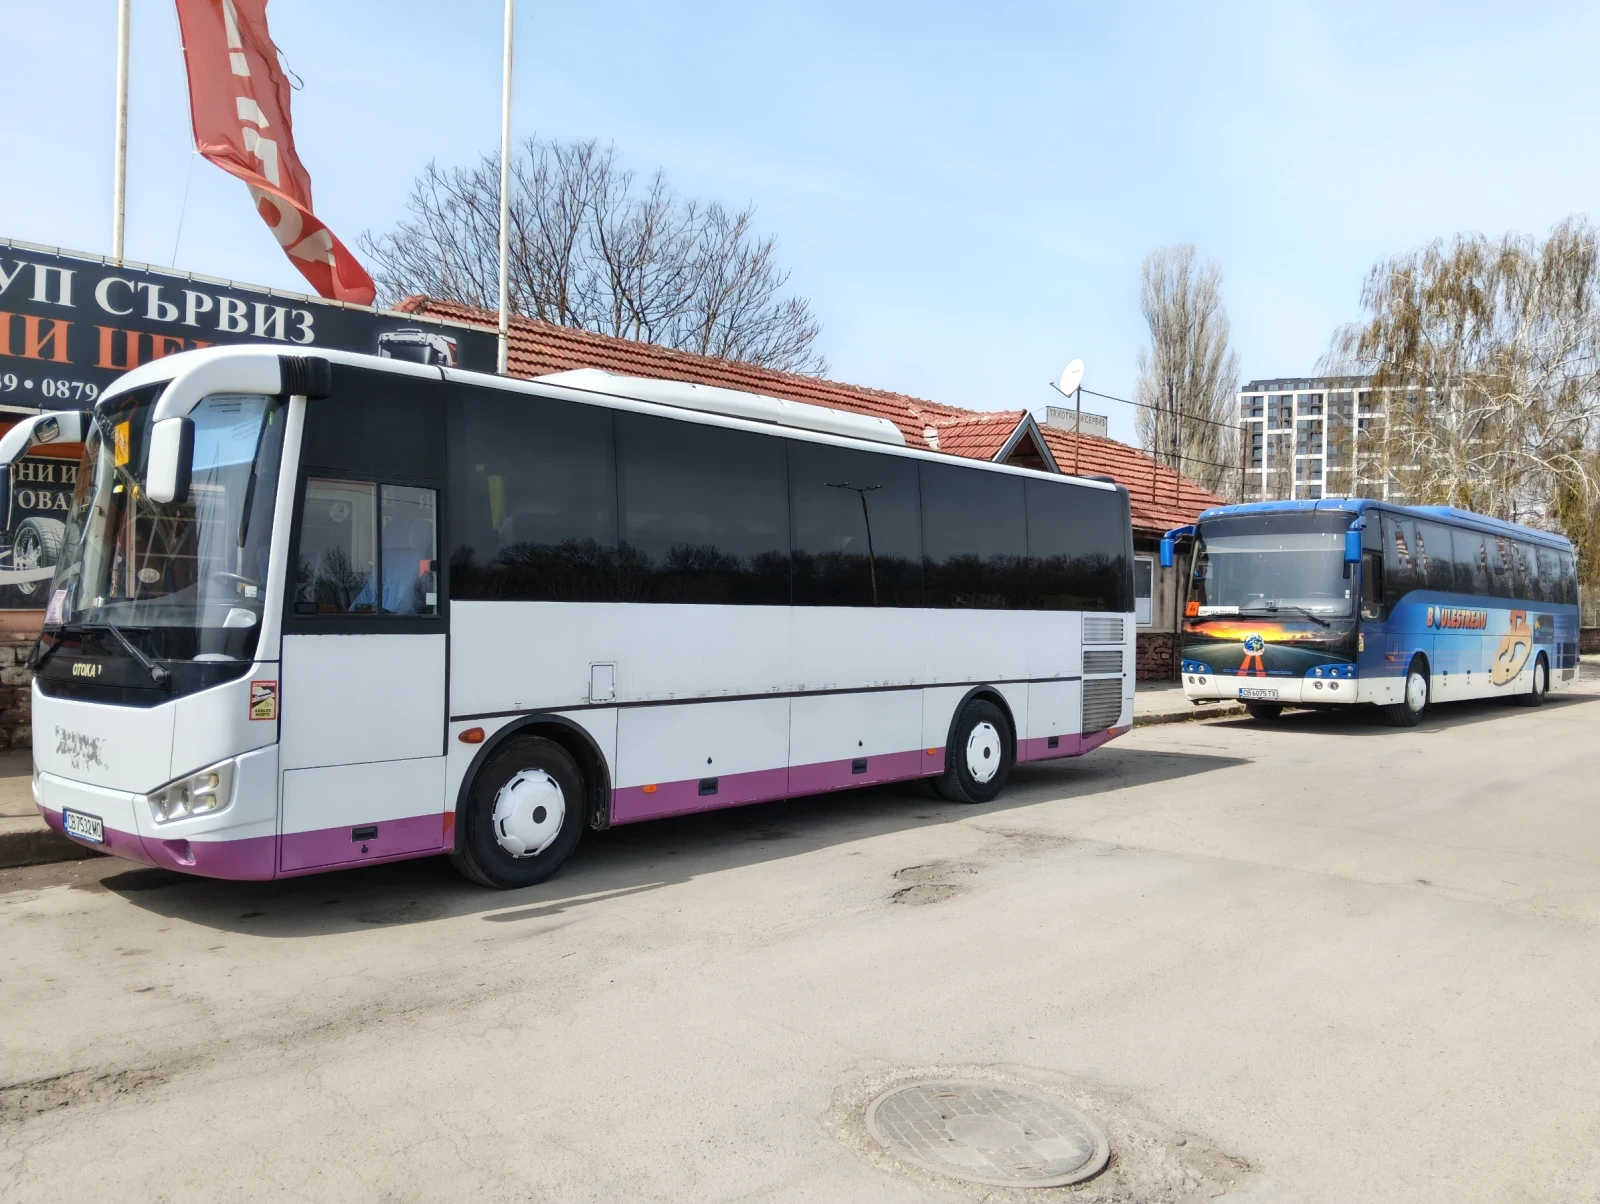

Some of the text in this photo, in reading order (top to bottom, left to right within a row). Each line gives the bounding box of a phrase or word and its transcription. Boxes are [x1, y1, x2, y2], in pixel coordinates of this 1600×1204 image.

[94, 276, 315, 345] СЪРВИЗ
[0, 373, 98, 402] 9 0879
